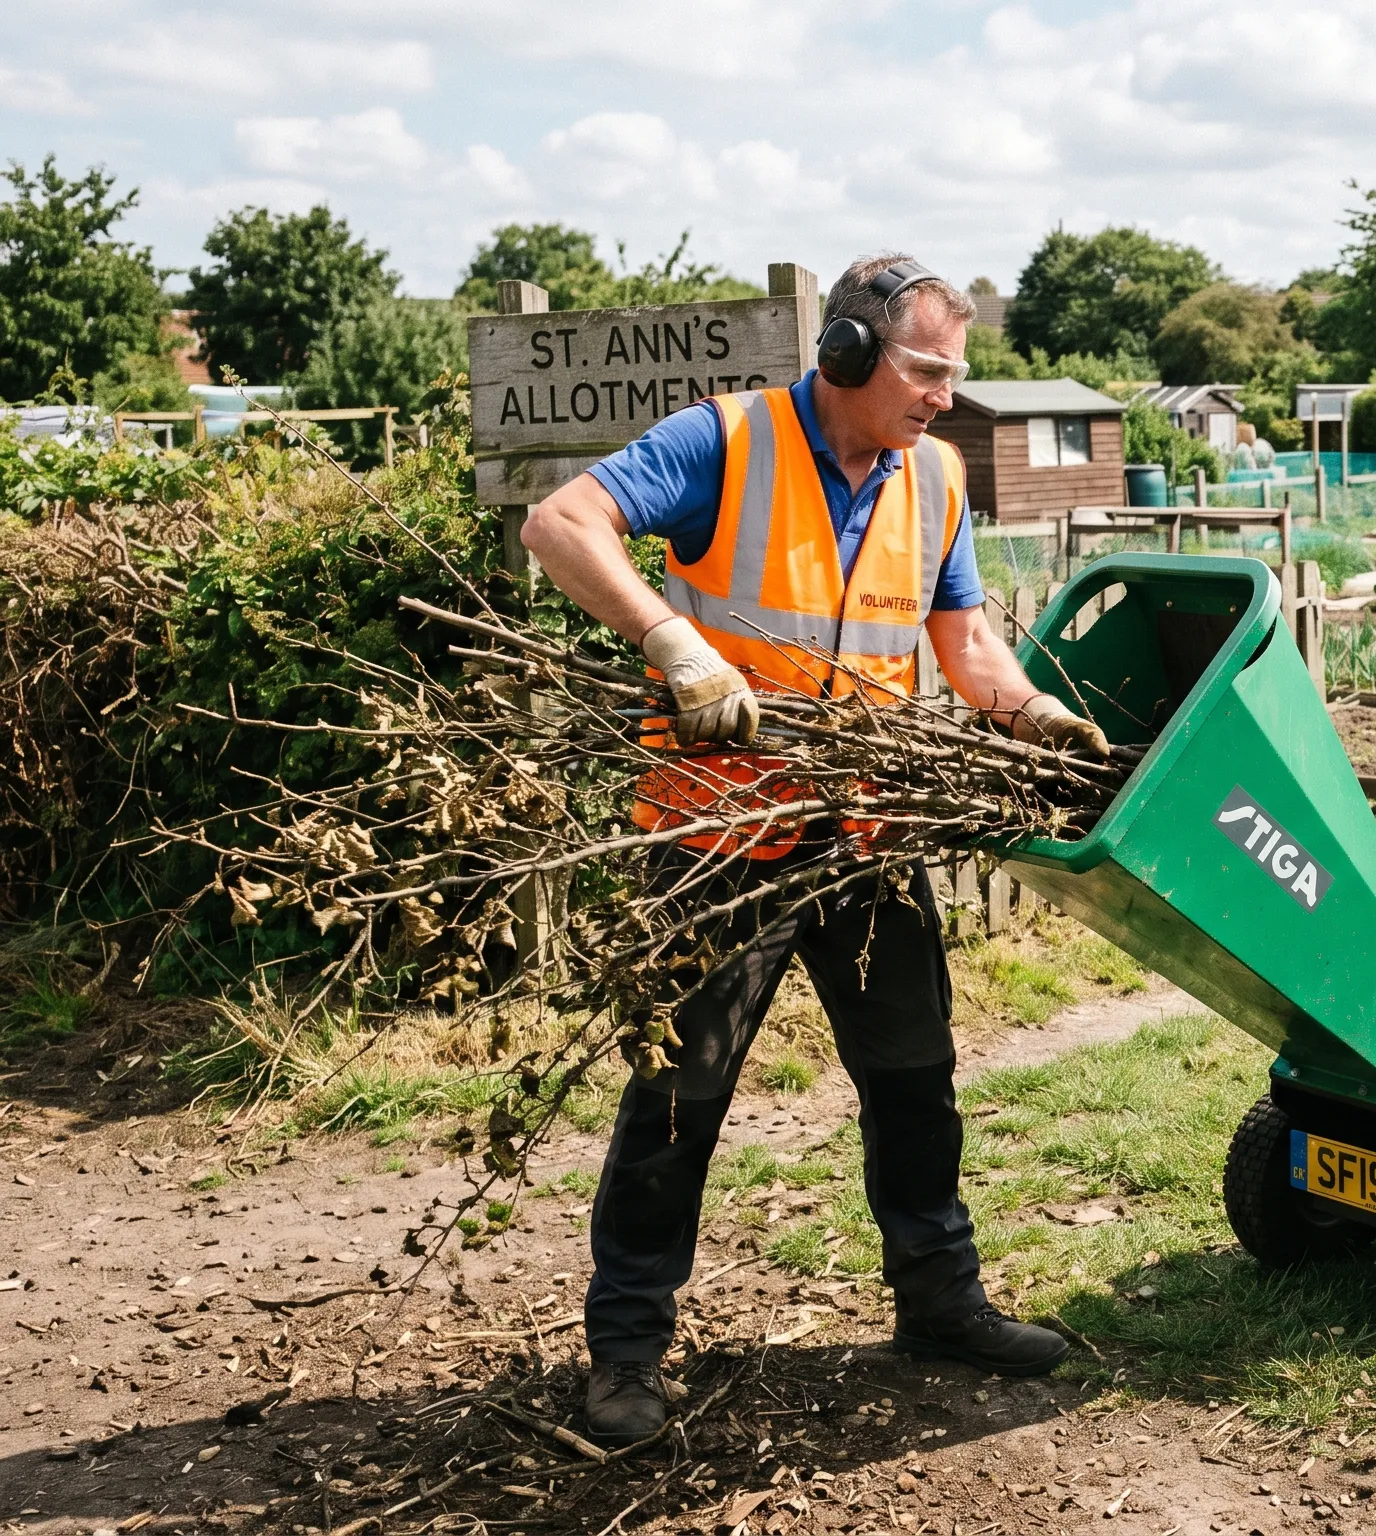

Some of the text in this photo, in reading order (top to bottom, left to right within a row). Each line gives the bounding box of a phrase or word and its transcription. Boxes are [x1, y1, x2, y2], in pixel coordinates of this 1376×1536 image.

[531, 315, 730, 369] ST. ANN'S
[859, 593, 918, 612] VOLUNTEER
[1218, 806, 1318, 907] STIGA
